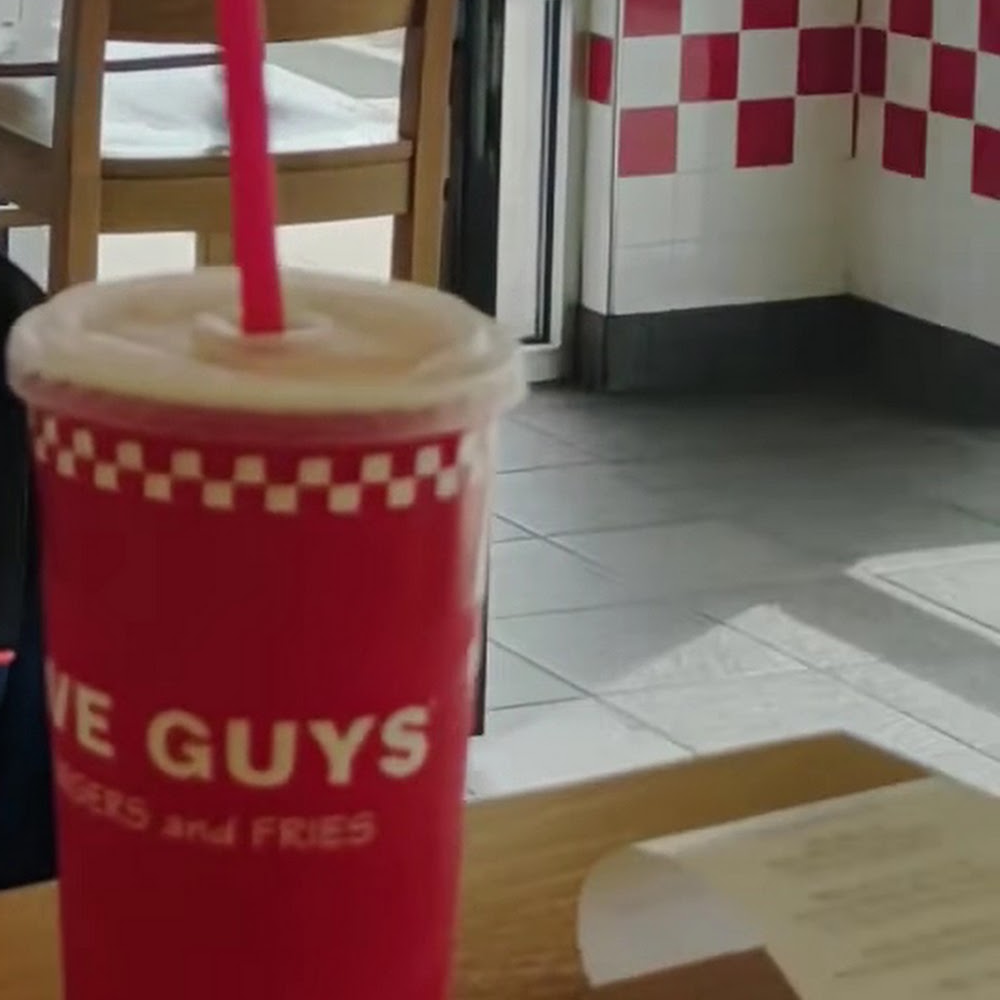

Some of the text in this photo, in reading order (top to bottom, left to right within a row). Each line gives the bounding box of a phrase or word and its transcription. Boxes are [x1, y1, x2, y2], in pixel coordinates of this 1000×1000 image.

[146, 705, 431, 788] GUYS
[162, 814, 236, 846] and
[252, 811, 377, 849] FRIES
